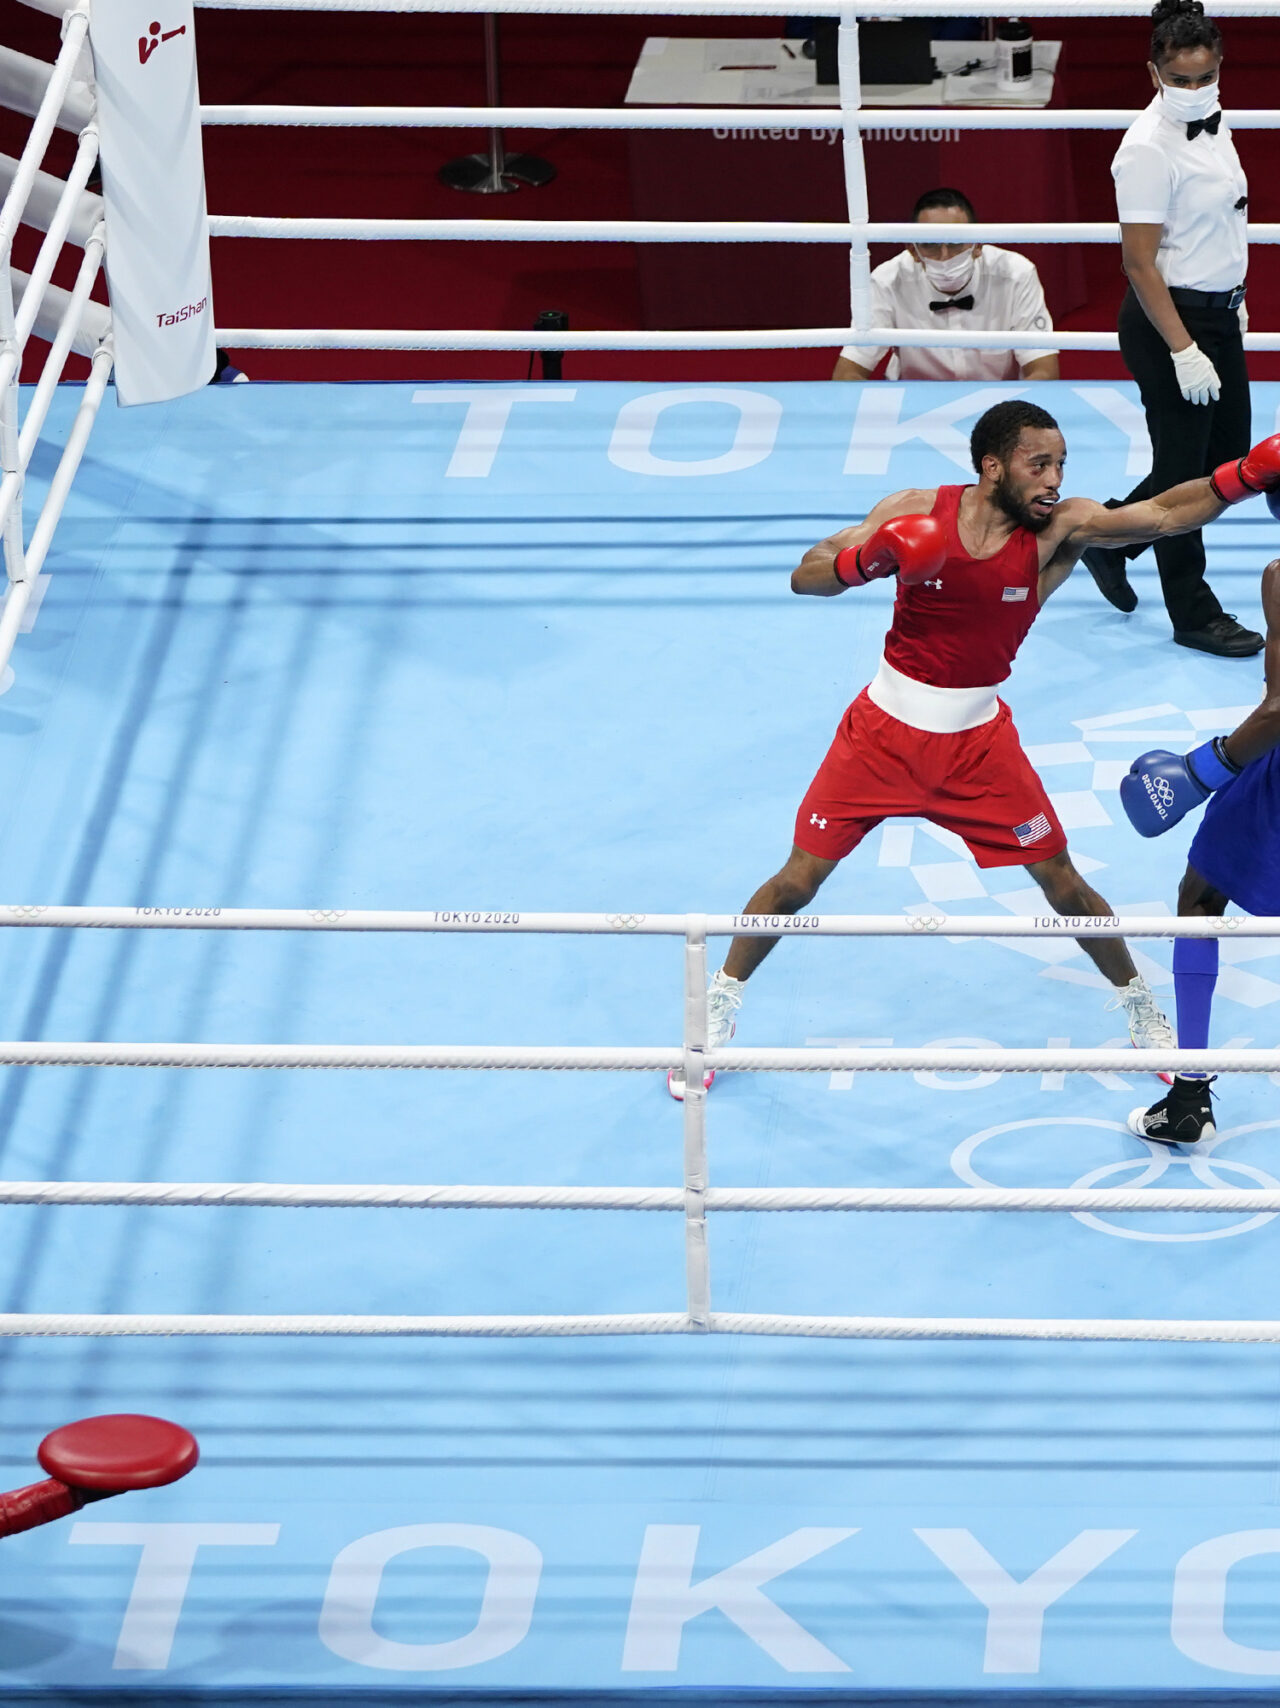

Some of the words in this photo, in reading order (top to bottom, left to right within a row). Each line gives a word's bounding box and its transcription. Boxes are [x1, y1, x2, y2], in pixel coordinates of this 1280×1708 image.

[811, 126, 838, 145] by
[859, 127, 961, 142] motion
[156, 297, 207, 328] TaiShan
[1141, 773, 1155, 795] 2020
[1149, 793, 1169, 821] TOKYO
[135, 906, 182, 916] TOKYO
[185, 907, 221, 917] 2020
[432, 911, 481, 923] TOKYO
[484, 912, 520, 924] 2020
[732, 916, 780, 928] TOKYO
[783, 916, 820, 928] 2020
[1033, 916, 1081, 928] TOKYO
[1084, 916, 1120, 928] 2020
